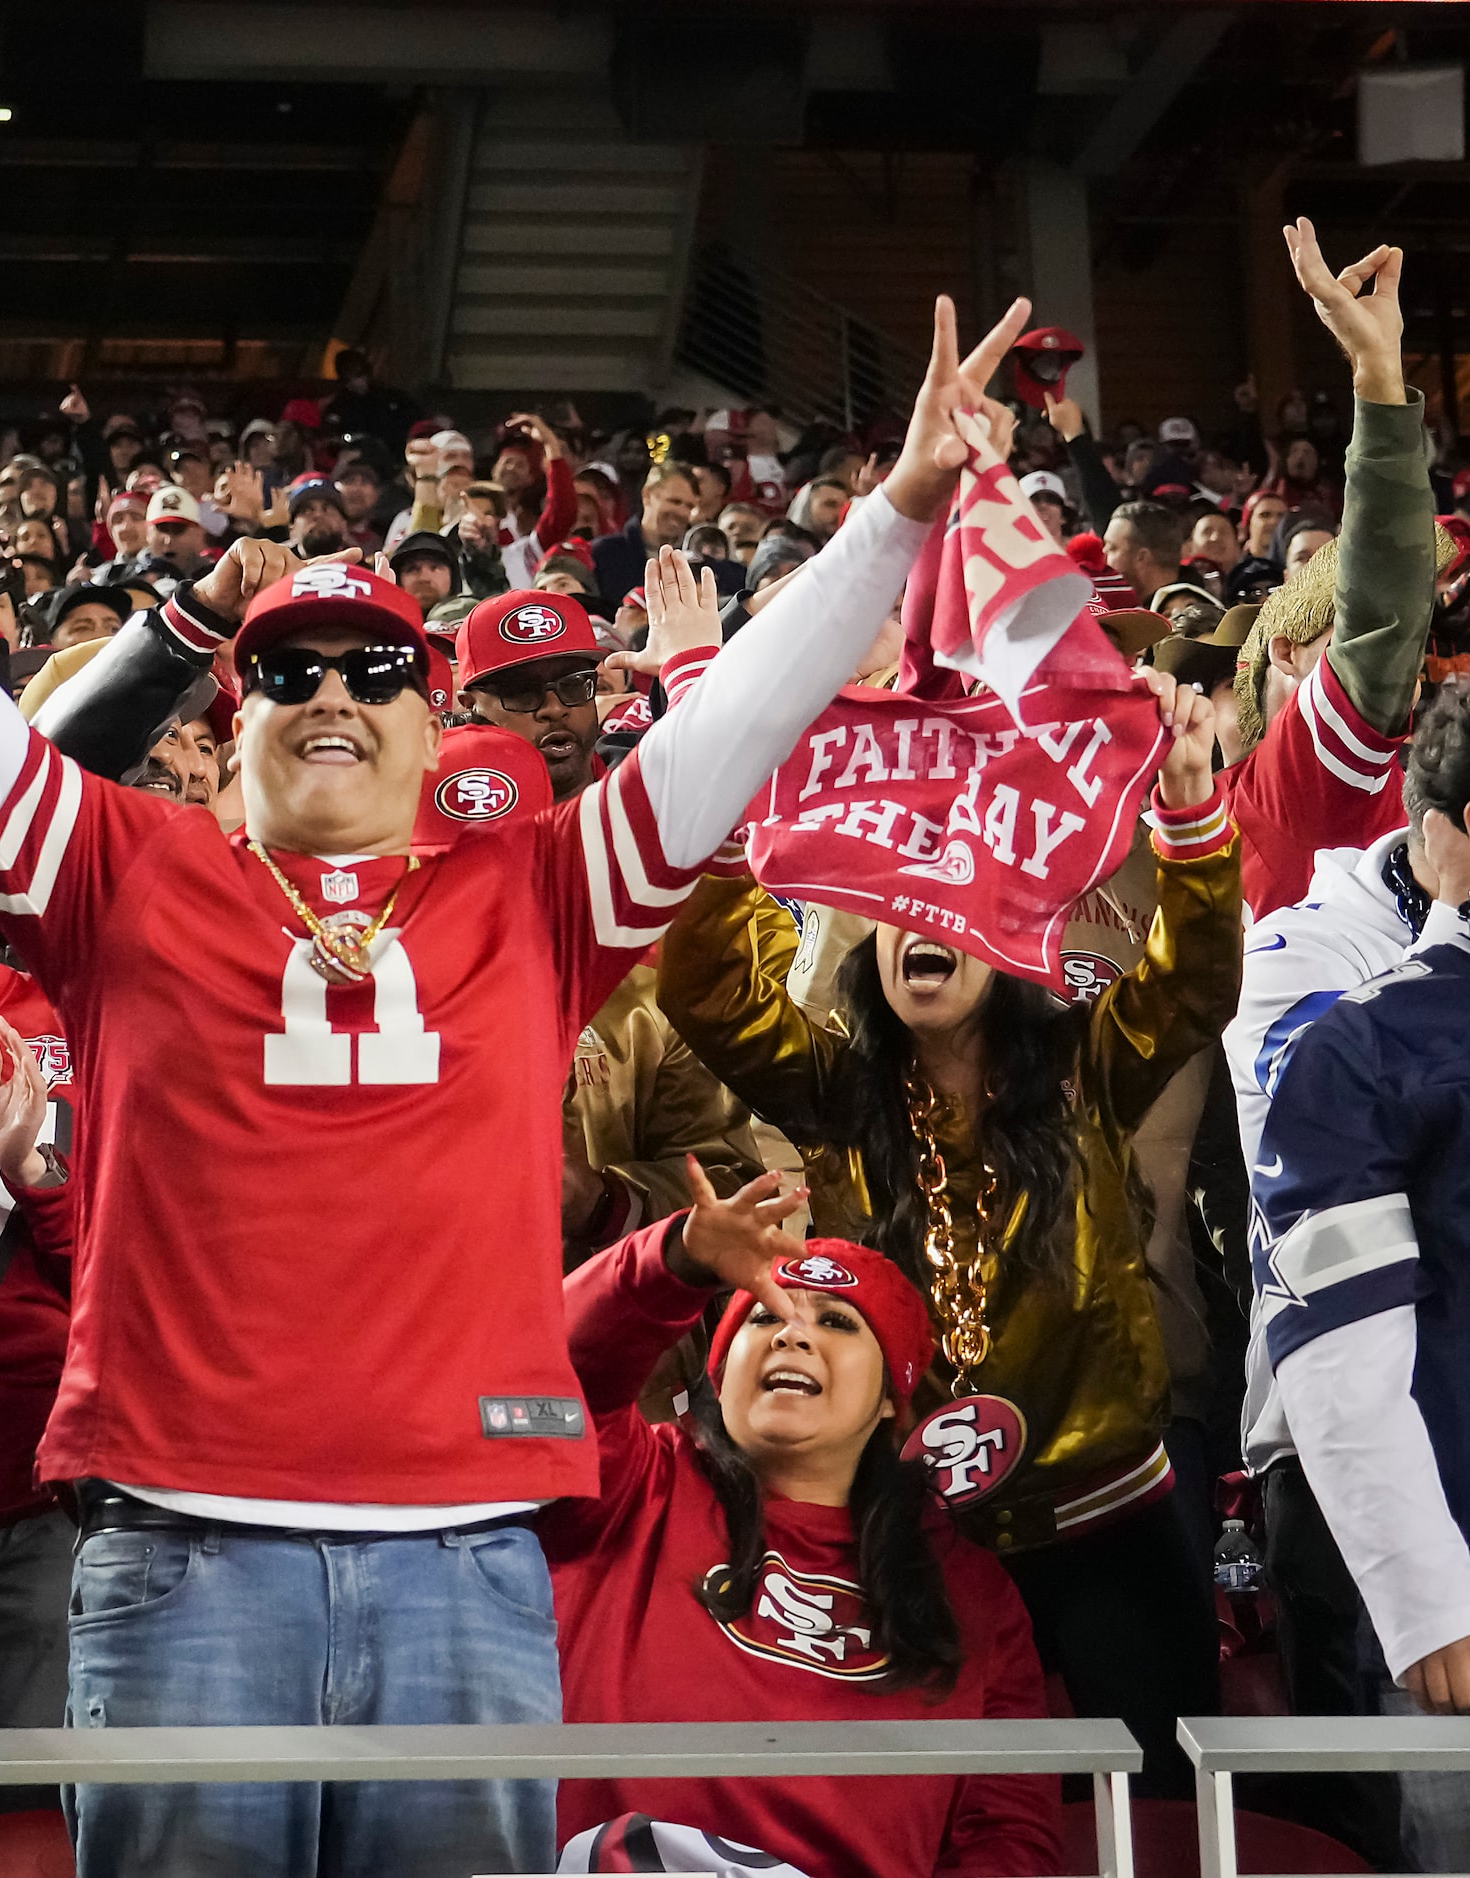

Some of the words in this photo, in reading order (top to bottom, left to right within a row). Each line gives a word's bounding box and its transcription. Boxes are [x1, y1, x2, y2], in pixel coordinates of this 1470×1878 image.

[518, 607, 557, 638] SF
[799, 717, 1112, 809] FAITHUL
[458, 775, 505, 815] SF
[790, 800, 944, 862] THE
[891, 893, 967, 934] #FTTB
[1064, 959, 1112, 1002] SF
[536, 1401, 558, 1417] XL
[922, 1405, 1004, 1496] SF
